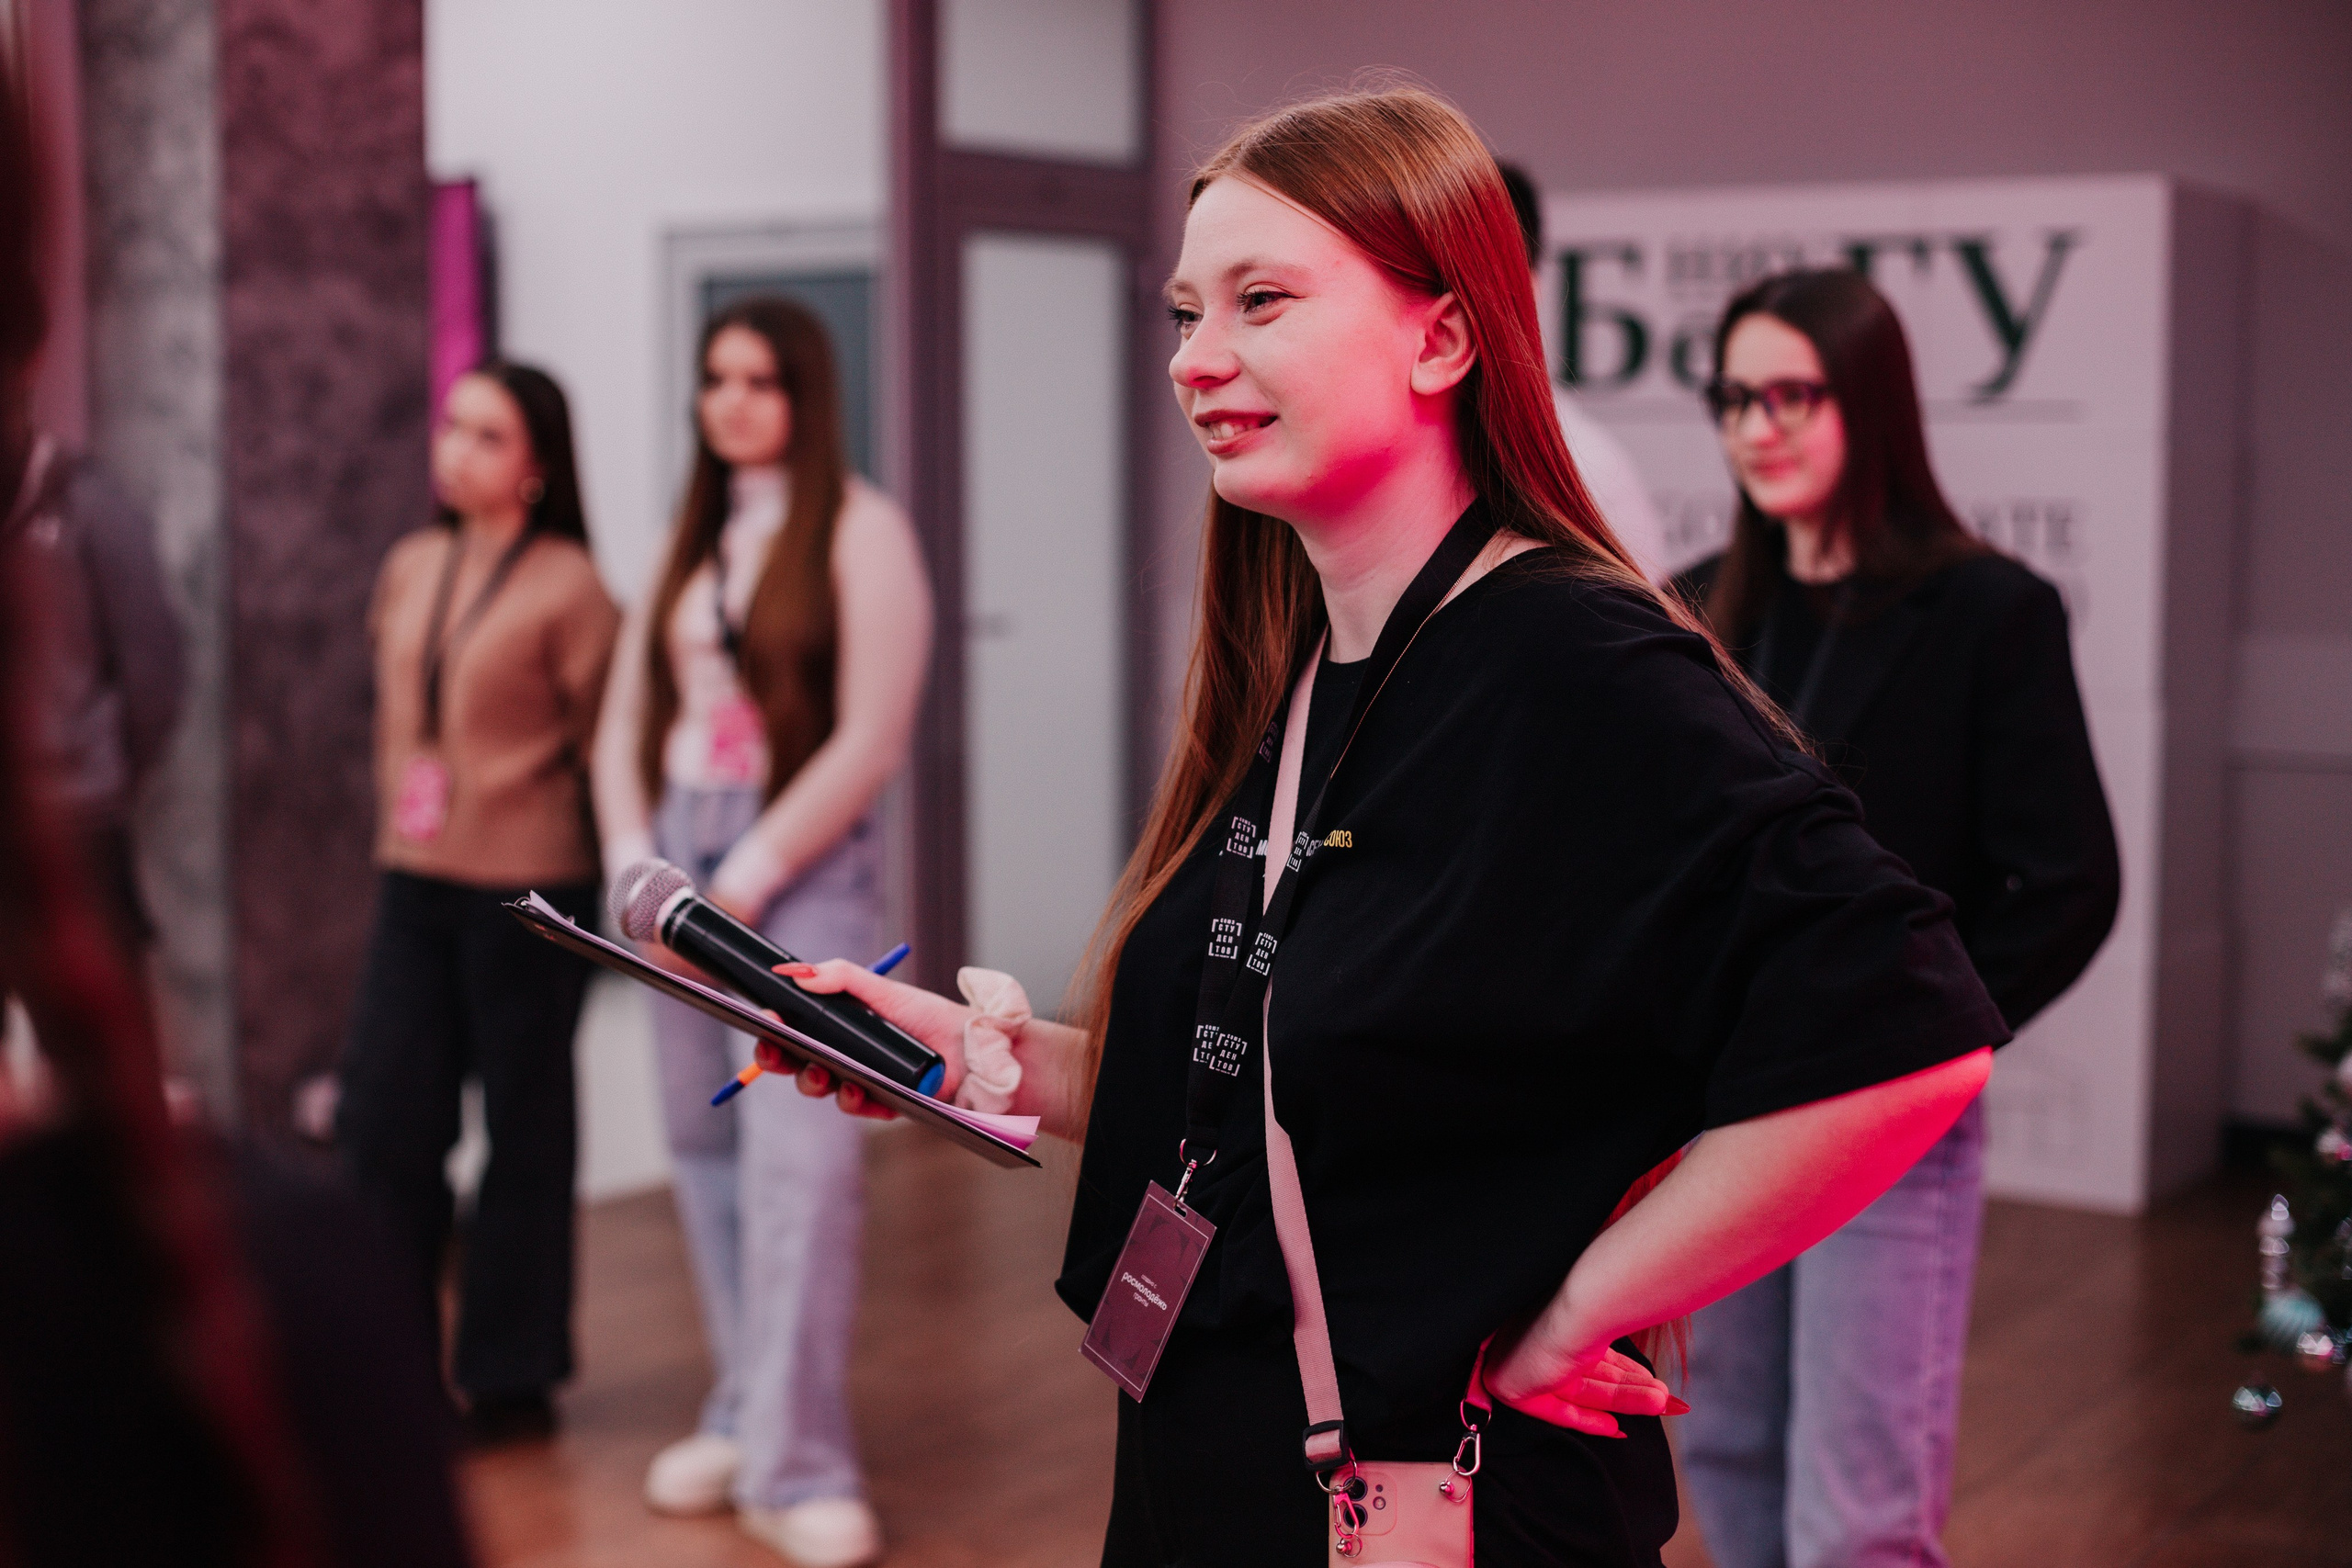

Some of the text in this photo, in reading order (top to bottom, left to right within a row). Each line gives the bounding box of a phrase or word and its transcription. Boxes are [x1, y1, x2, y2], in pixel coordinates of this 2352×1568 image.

[1218, 923, 1235, 933] СТУ
[1216, 933, 1234, 943] ДЕН
[1260, 938, 1272, 949] СТУ
[1216, 945, 1231, 955] ТОВ
[1255, 948, 1269, 960] ДЕН
[1252, 958, 1265, 970] ТОВ
[1224, 1039, 1240, 1050] СТУ
[1219, 1049, 1238, 1061] ДЕН
[1217, 1060, 1233, 1071] ТОВ
